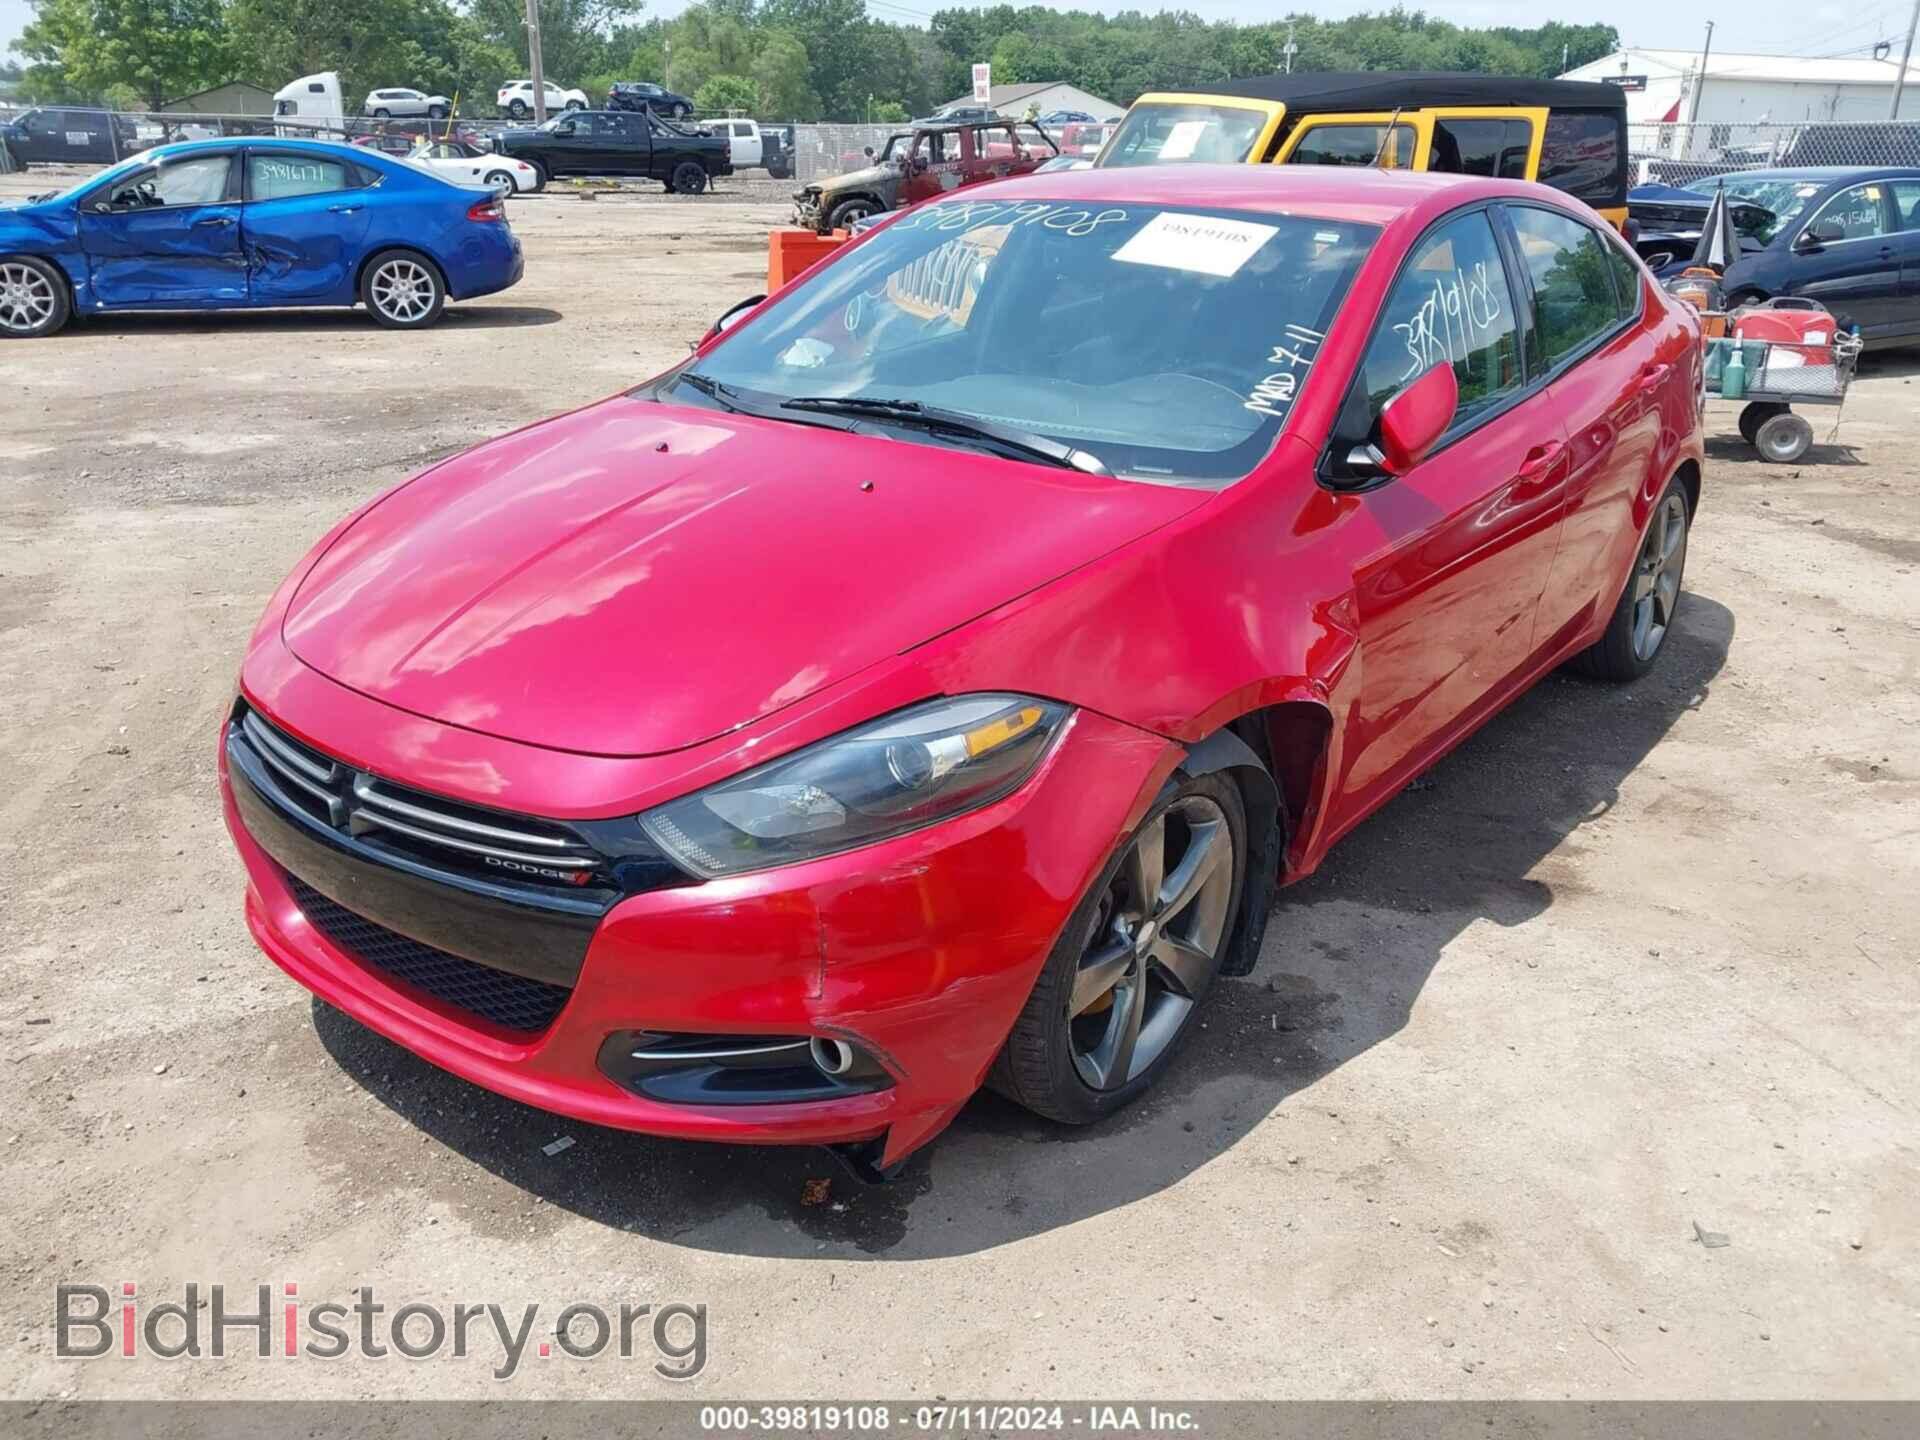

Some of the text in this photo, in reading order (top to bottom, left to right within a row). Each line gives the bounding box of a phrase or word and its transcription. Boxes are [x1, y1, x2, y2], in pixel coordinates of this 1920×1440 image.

[892, 202, 1130, 237] 39819108
[1392, 260, 1500, 381] 39819108
[1267, 324, 1325, 367] 7-11
[484, 856, 577, 881] DODGE
